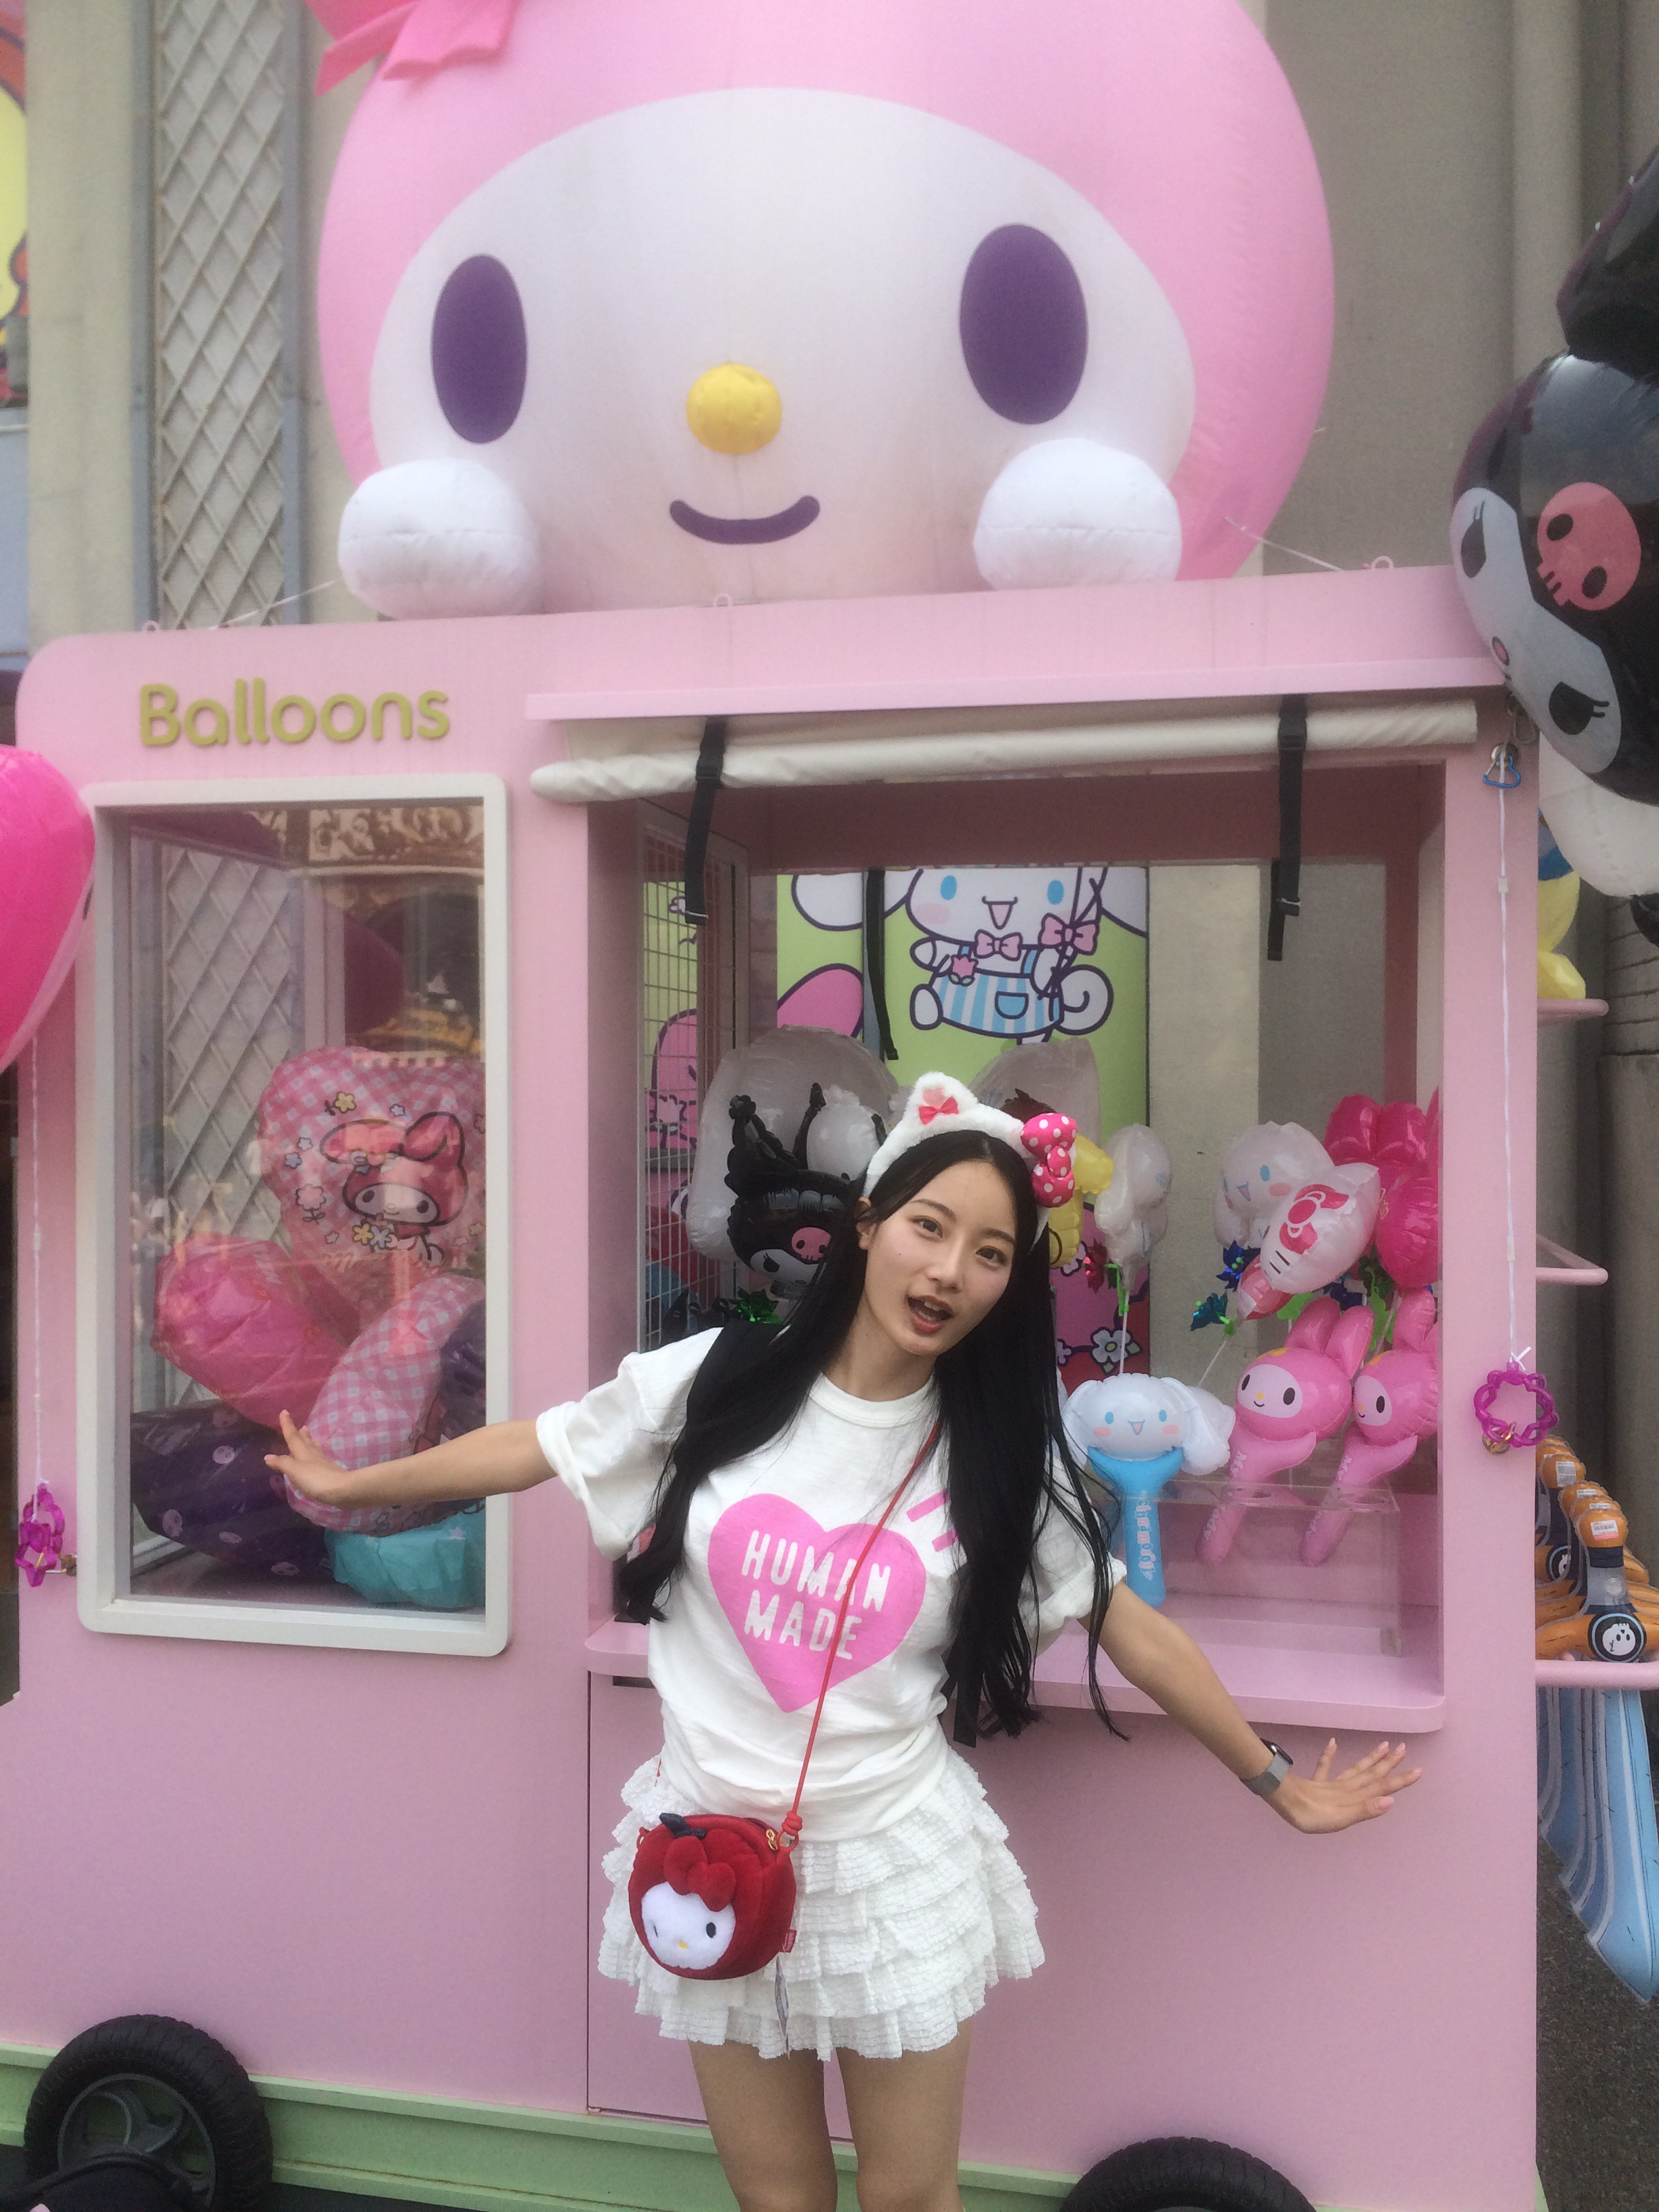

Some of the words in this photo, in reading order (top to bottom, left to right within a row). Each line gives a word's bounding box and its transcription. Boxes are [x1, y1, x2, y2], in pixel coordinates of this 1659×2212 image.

[140, 677, 451, 747] Balloons
[741, 1530, 891, 1612] HUMAN
[744, 1589, 863, 1660] MADE
